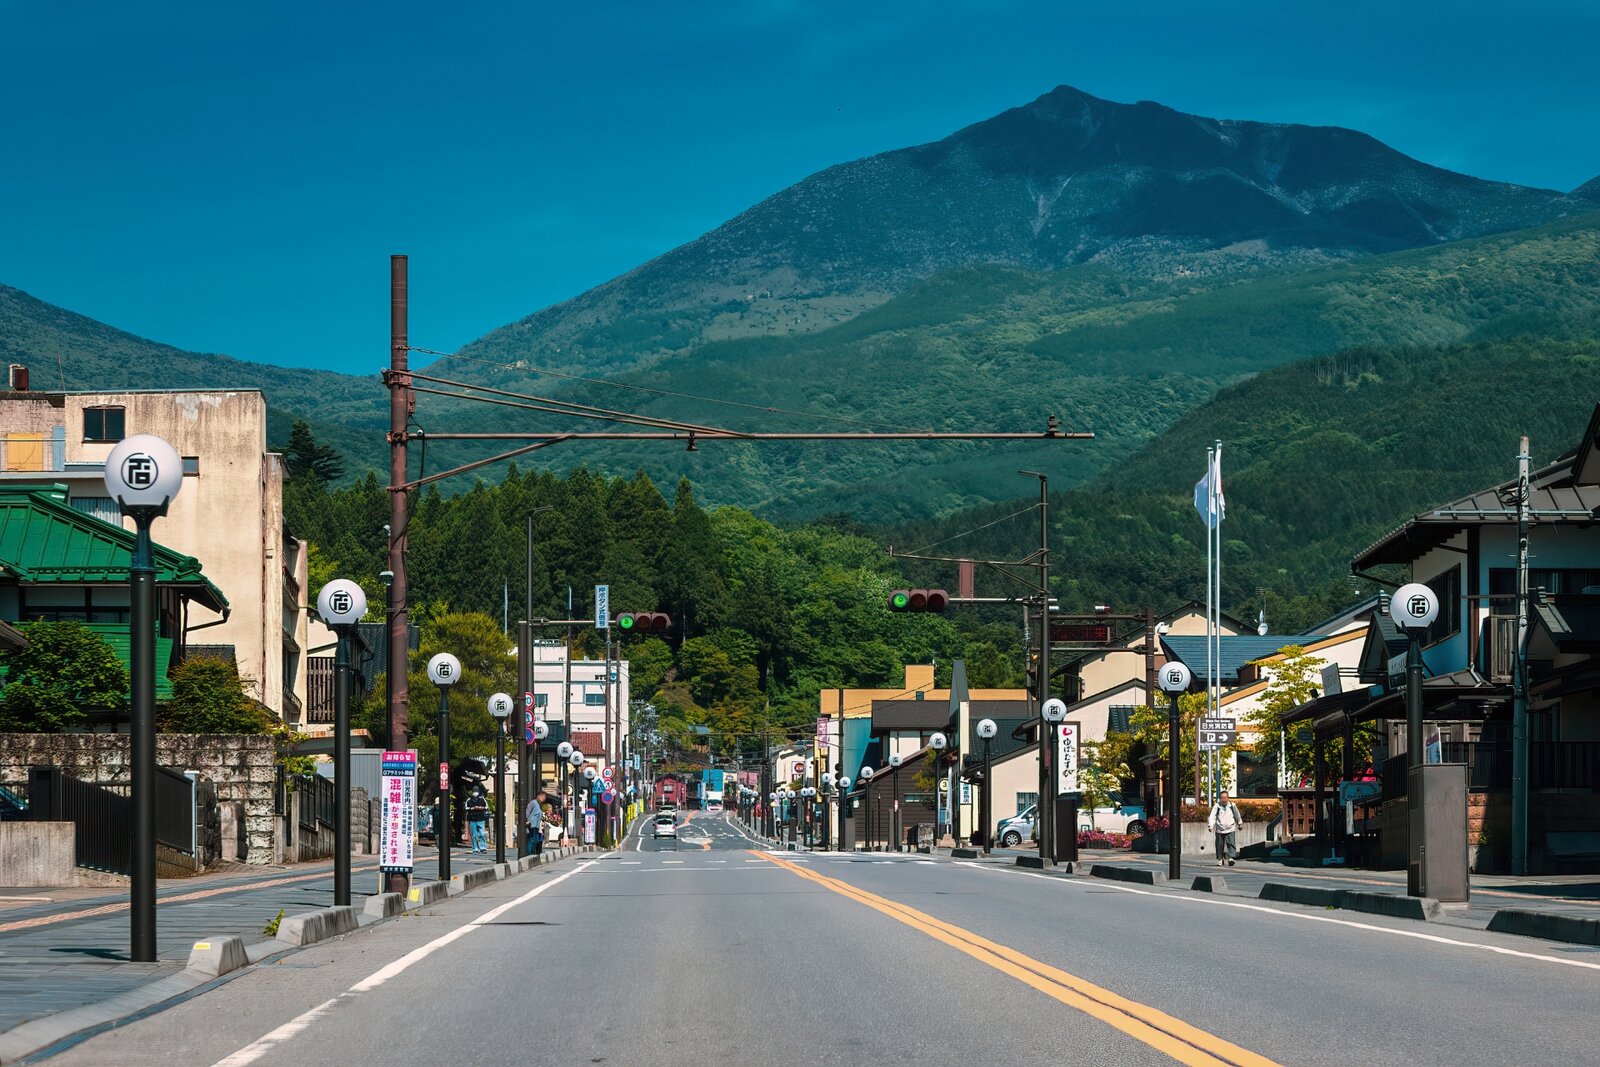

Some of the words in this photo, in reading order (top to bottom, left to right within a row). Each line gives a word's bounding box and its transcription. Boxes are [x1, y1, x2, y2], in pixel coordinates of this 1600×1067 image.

[386, 753, 412, 761] お知らせ
[389, 778, 402, 864] 混雑が予想されます
